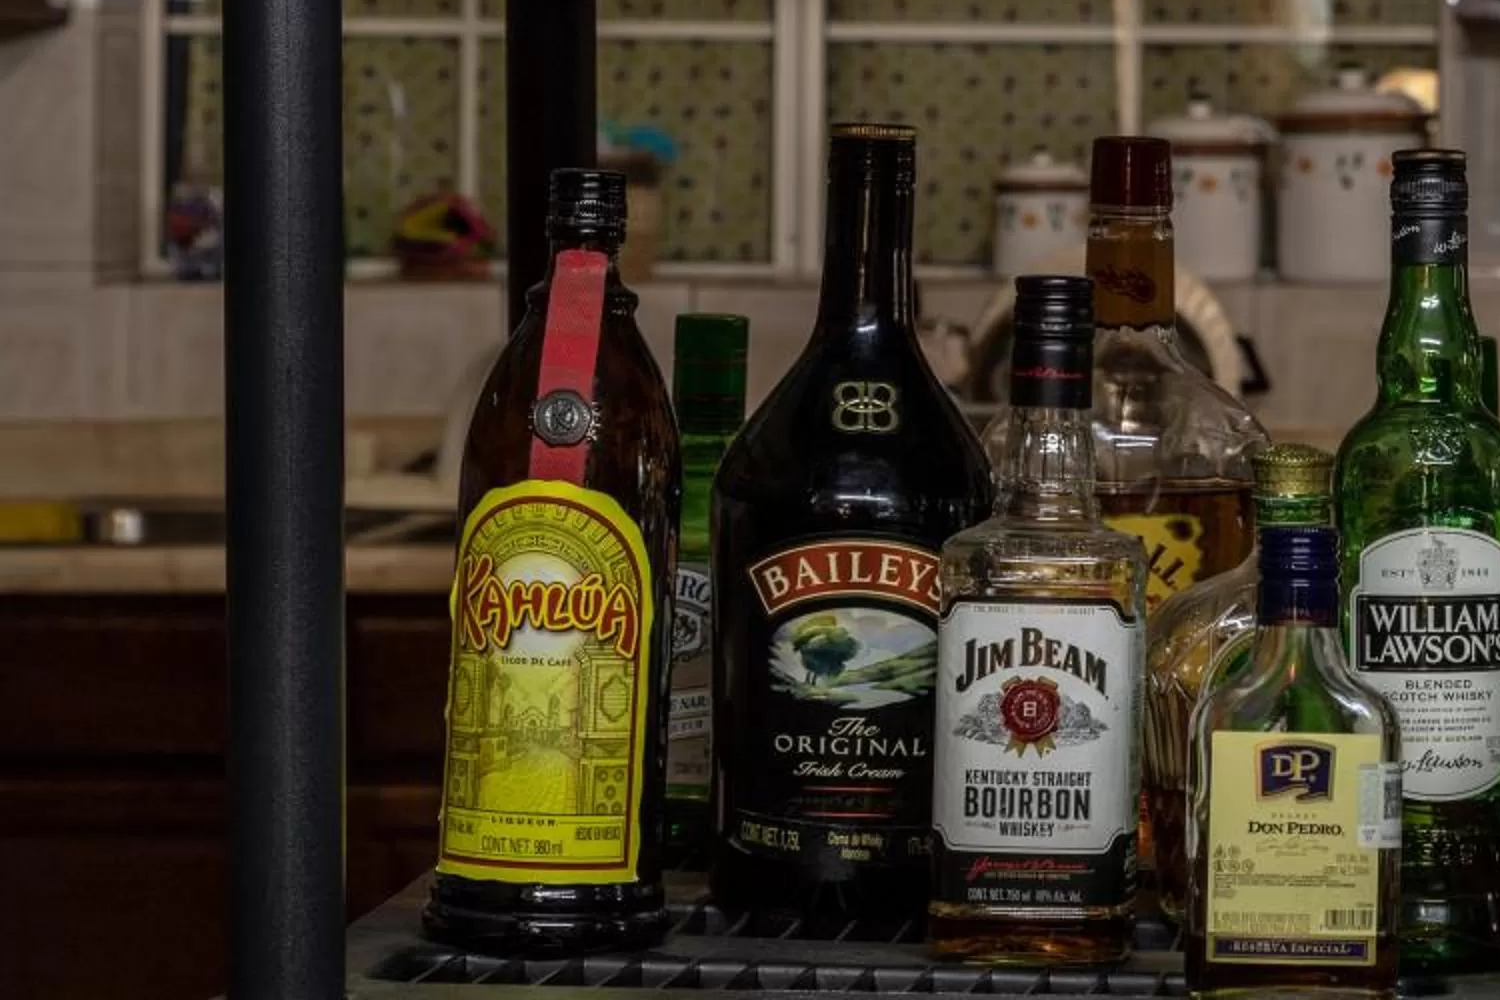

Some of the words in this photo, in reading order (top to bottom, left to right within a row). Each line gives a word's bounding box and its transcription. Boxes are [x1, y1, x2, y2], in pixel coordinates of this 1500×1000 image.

[767, 551, 941, 600] BAILEYS
[460, 553, 640, 660] KAHLÚA
[1369, 603, 1499, 634] WILLIAM
[956, 638, 1014, 692] JIM
[1019, 627, 1107, 696] BEAM
[1405, 680, 1472, 689] BLENDED
[1443, 690, 1493, 701] WHISKY
[828, 716, 881, 737] The
[774, 733, 926, 757] ORIGINAL
[792, 761, 843, 777] Irish
[847, 762, 905, 779] Cream
[965, 769, 1027, 785] KENTUCKY
[1033, 771, 1091, 787] STRAIGHT
[964, 786, 1090, 820] BOURBON
[1000, 821, 1054, 837] WHISKEY
[1248, 820, 1283, 835] DON
[1287, 821, 1343, 836] PEDRO
[1230, 936, 1287, 954] RESERVA
